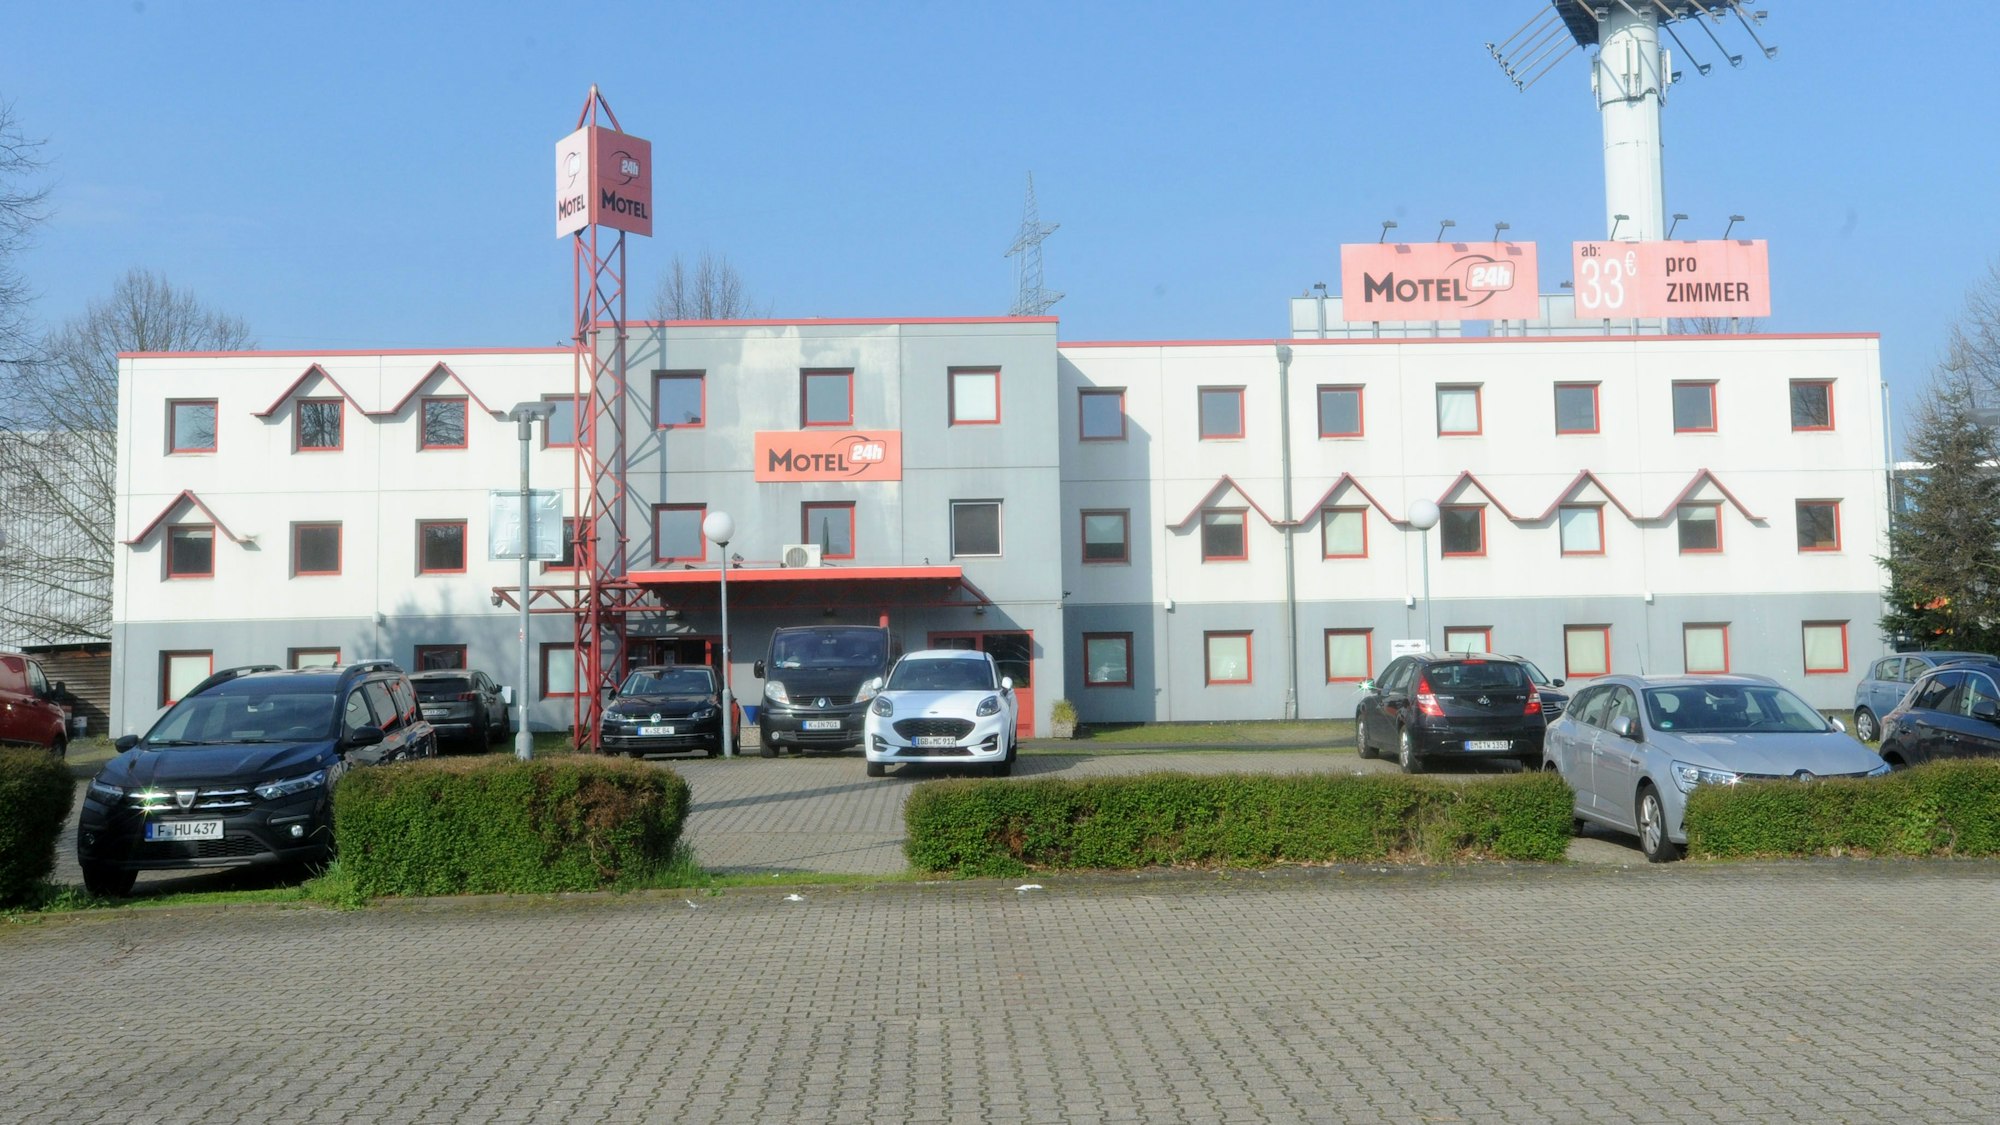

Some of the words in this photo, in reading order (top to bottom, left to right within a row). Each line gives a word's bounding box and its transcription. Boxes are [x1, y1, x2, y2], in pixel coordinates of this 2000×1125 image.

[620, 159, 640, 176] 24h
[558, 194, 586, 221] MOTEL
[602, 187, 649, 219] MOTEL
[1581, 243, 1601, 257] ab:
[1665, 256, 1697, 277] pro
[1363, 271, 1469, 303] MOTEL
[1471, 265, 1511, 288] 24h
[1666, 282, 1750, 303] ZIMMER
[768, 447, 849, 473] MOTEL
[851, 443, 883, 461] 24h
[157, 824, 166, 836] F
[174, 823, 191, 836] HU
[193, 822, 217, 835] 437
